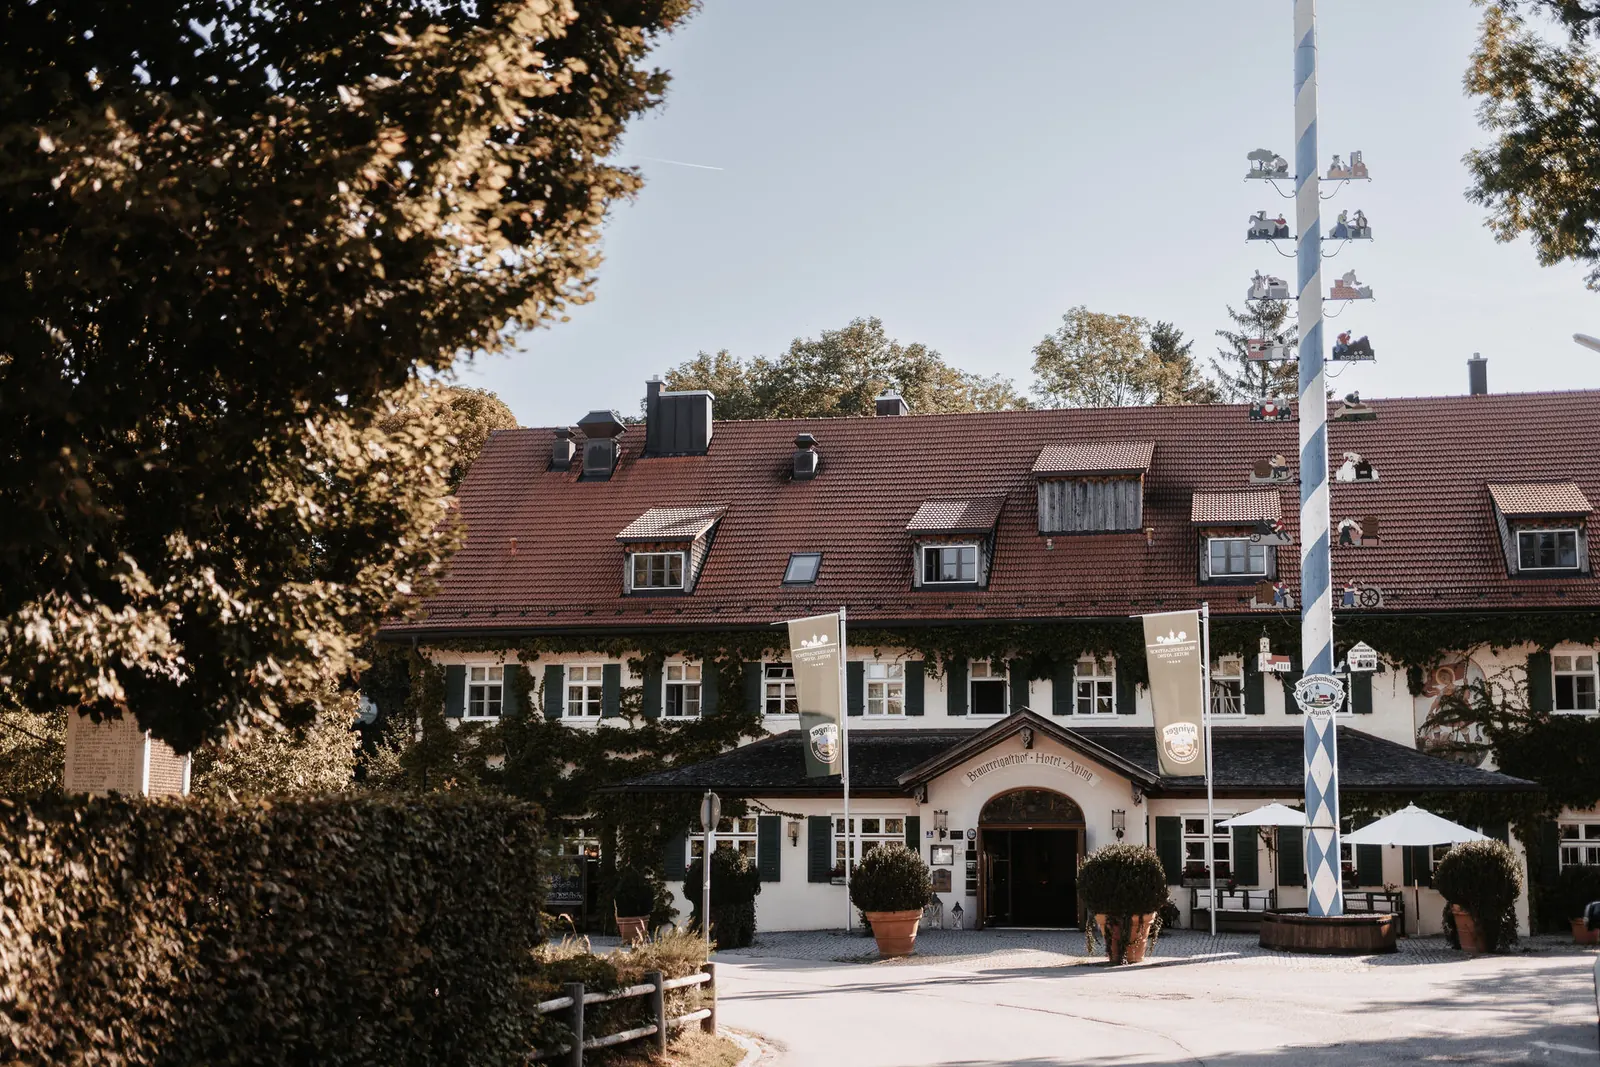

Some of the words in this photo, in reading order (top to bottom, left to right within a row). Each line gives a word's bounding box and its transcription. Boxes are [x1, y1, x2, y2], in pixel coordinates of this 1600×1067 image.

[967, 752, 1029, 782] Brauereigasthof
[1035, 753, 1061, 767] Hotel
[1066, 760, 1093, 782] Aying
